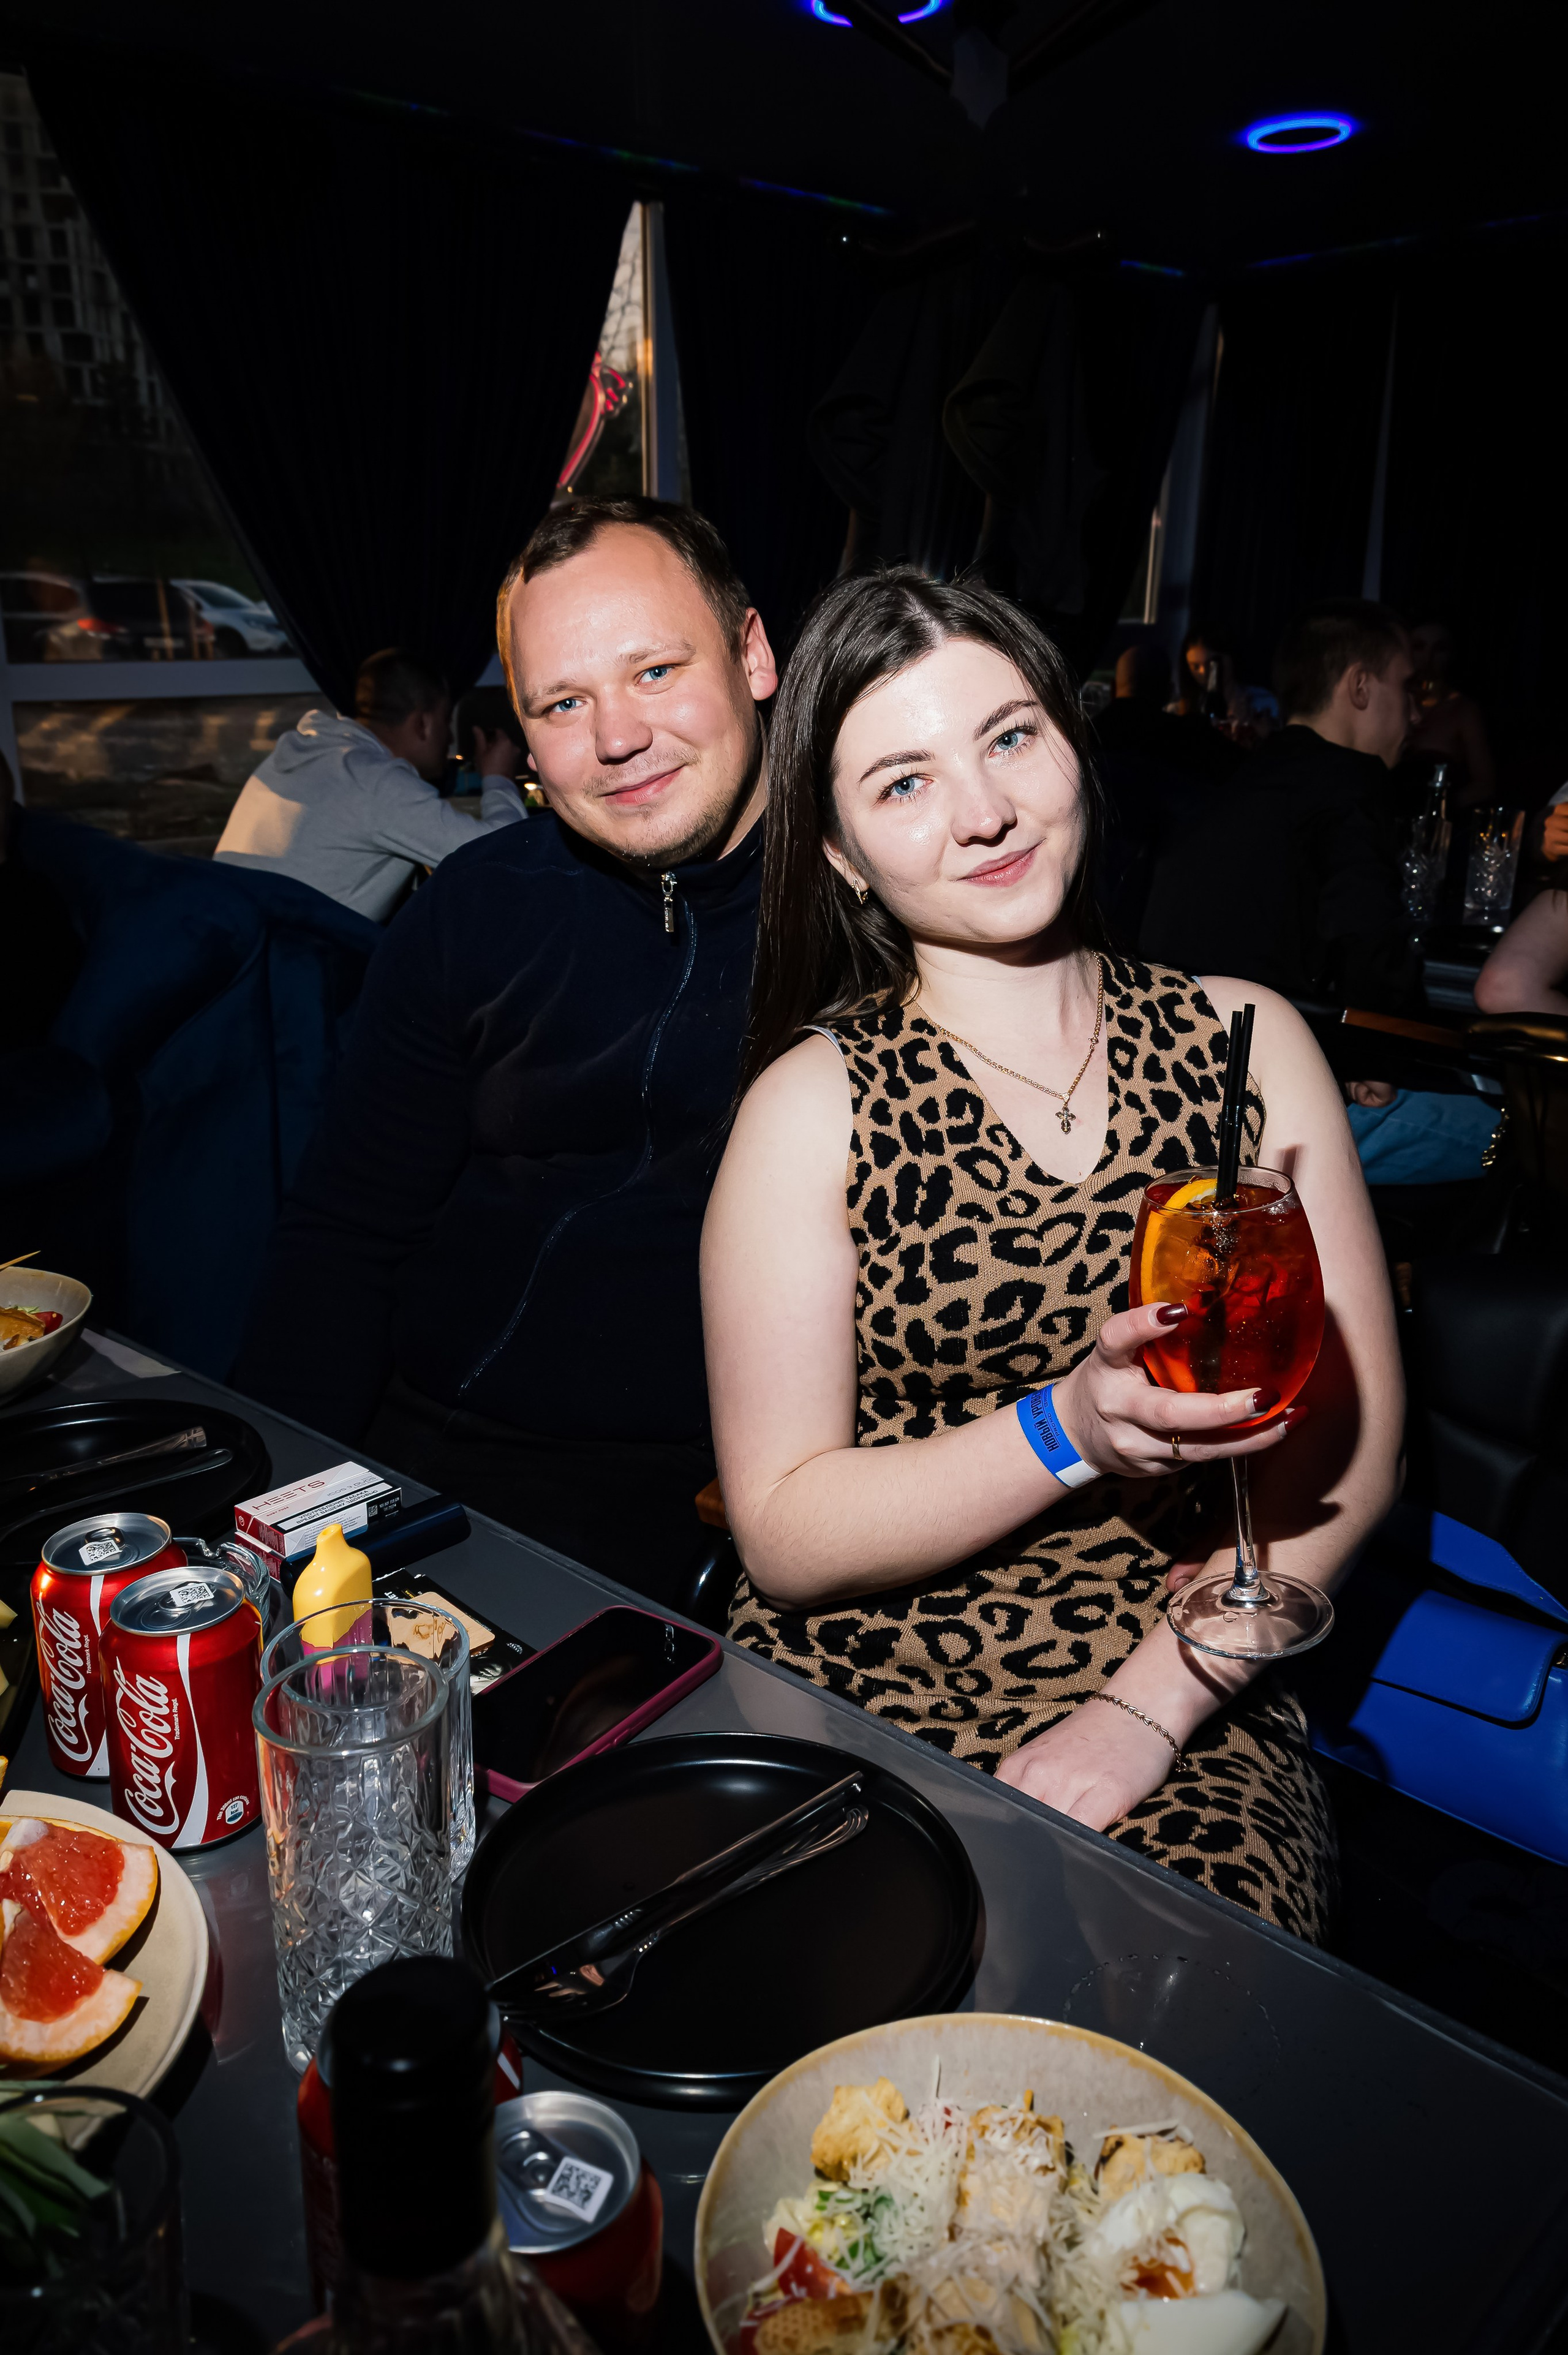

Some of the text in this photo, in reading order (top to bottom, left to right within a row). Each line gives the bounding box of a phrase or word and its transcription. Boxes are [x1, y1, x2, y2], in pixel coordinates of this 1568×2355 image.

[1034, 1418, 1060, 1452] НОВЫЙ
[1047, 1412, 1060, 1436] PROMO
[252, 1480, 325, 1510] HEETS
[296, 1513, 320, 1524] ВРЕДИТ
[320, 1502, 345, 1515] ВАШЕМУ
[345, 1490, 378, 1504] ЗДОРОВЬЮ
[300, 1490, 369, 1519] УПОТРЕБЛЕНИЕ ТАБАКА
[36, 1596, 92, 1762] Coca-Cola
[113, 1656, 179, 1834] Coca-Cola
